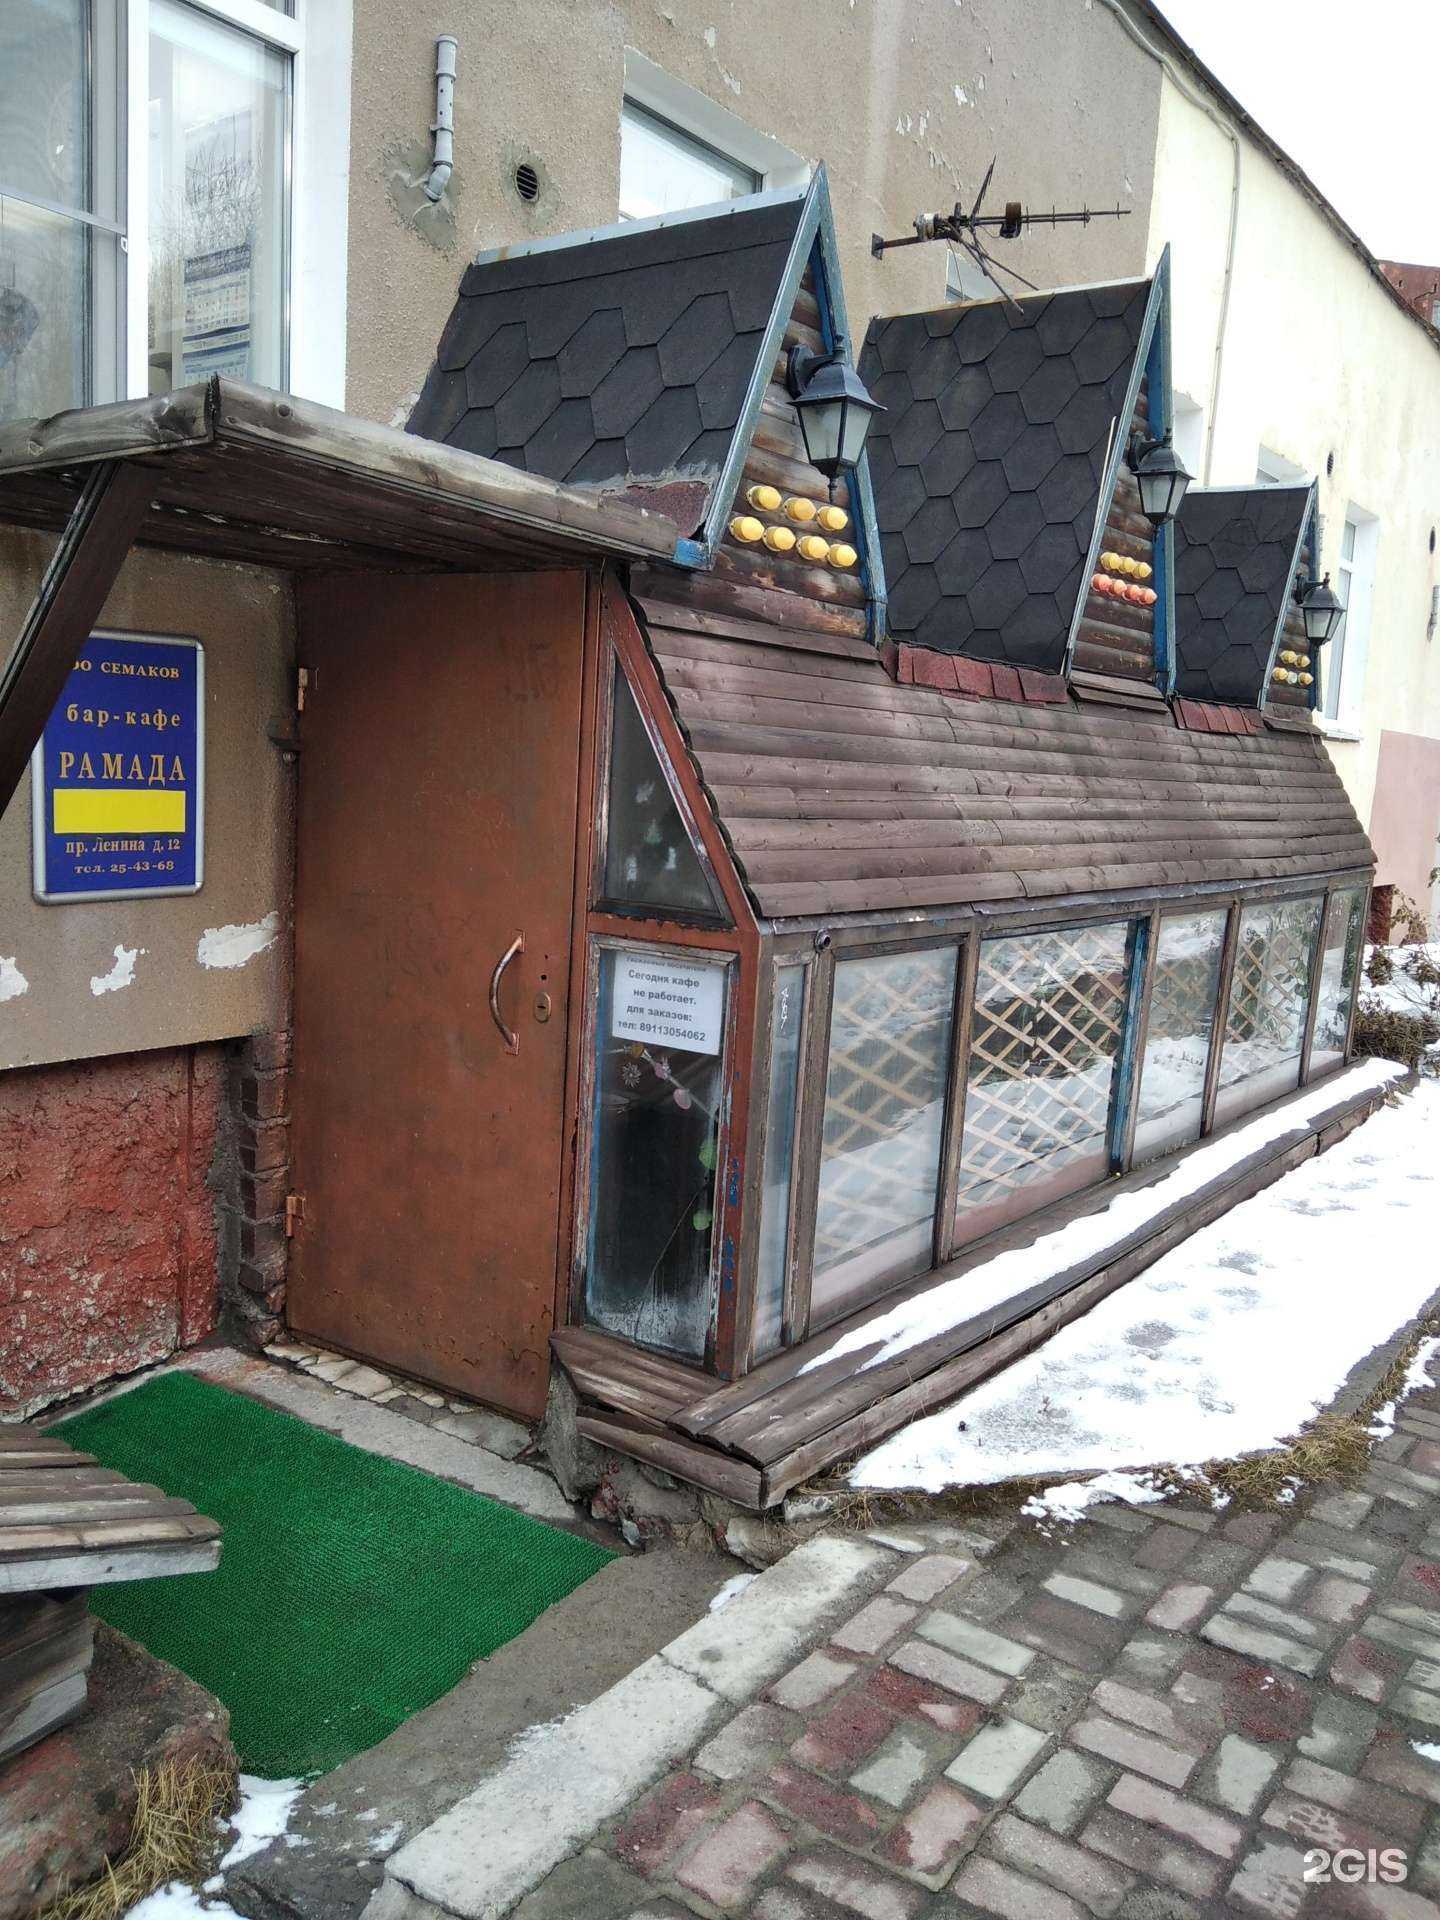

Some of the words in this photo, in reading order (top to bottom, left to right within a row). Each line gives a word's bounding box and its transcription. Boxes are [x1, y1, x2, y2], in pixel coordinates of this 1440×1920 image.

[101, 661, 180, 679] СЕМАКОВ
[66, 703, 181, 731] бар-кафе
[59, 751, 187, 787] РАМАДА
[65, 840, 89, 858] пр.
[92, 837, 145, 853] Ленина
[152, 839, 164, 854] д.
[167, 838, 181, 851] 12
[74, 864, 106, 875] тел.
[110, 860, 175, 875] 25-43-68
[628, 969, 670, 984] Сегодня
[672, 977, 700, 989] кафе
[633, 989, 646, 998] не
[648, 991, 697, 1006] работает.
[626, 1004, 645, 1014] для
[647, 1008, 692, 1022] заказов:
[617, 1020, 637, 1030] тел:
[640, 1022, 706, 1042] 89113054062
